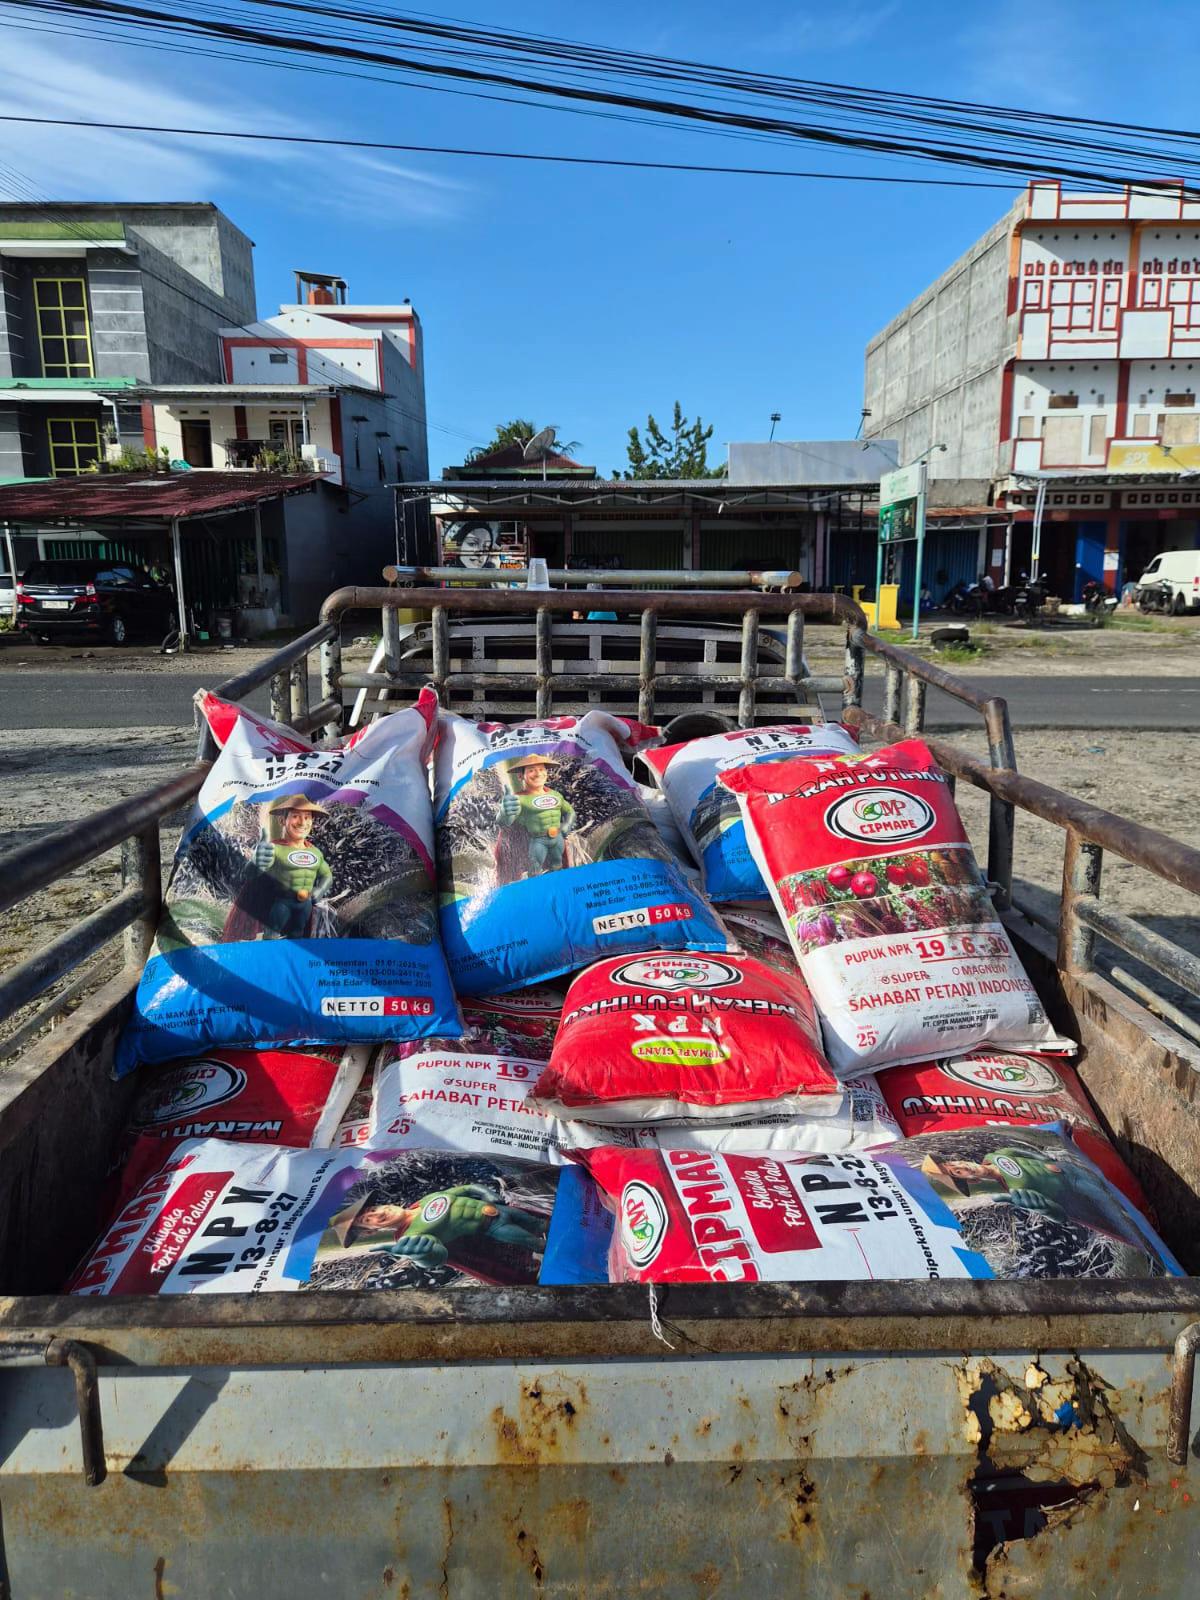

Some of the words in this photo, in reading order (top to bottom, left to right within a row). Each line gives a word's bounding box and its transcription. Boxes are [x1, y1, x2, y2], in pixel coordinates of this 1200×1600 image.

[859, 819, 918, 834] CIPMAPE
[598, 912, 646, 931] NETTO
[655, 907, 671, 920] 50
[675, 906, 691, 918] kg
[844, 946, 886, 965] PUPUK
[888, 943, 913, 960] NPK
[916, 939, 946, 959] 19
[961, 937, 976, 954] 6
[643, 960, 710, 970] CIPMAPE
[891, 970, 930, 984] SUPER
[961, 964, 1008, 976] MAGNUM
[326, 1001, 380, 1012] NETTO
[390, 999, 408, 1011] 50
[413, 999, 431, 1013] kg
[692, 993, 797, 1018] MERAH
[848, 988, 922, 1012] SAHABAT
[925, 980, 977, 1000] PETANI
[636, 1046, 675, 1056] GIANT
[856, 1032, 876, 1047] 25
[416, 1059, 461, 1071] PUPUK
[464, 1060, 492, 1070] NPK
[496, 1063, 529, 1079] 19
[399, 1089, 482, 1107] SAHABAT
[455, 1079, 498, 1092] SUPER
[902, 1095, 1033, 1121] PUTIHKU
[387, 1118, 410, 1135] 25
[471, 1125, 482, 1134] PT.
[484, 1128, 506, 1138] CIPTA
[507, 1132, 540, 1143] MAKMUR
[768, 1178, 793, 1199] de
[774, 1197, 806, 1228] Ferti
[892, 1189, 913, 1215] unsur
[669, 1150, 761, 1282] CIPMAP
[178, 1185, 275, 1276] NPK
[233, 1192, 299, 1273] 13-8-27
[149, 1241, 181, 1275] Ferti
[170, 1226, 192, 1246] de
[263, 1237, 287, 1268] unsur
[908, 1217, 940, 1280] Diperkaya
